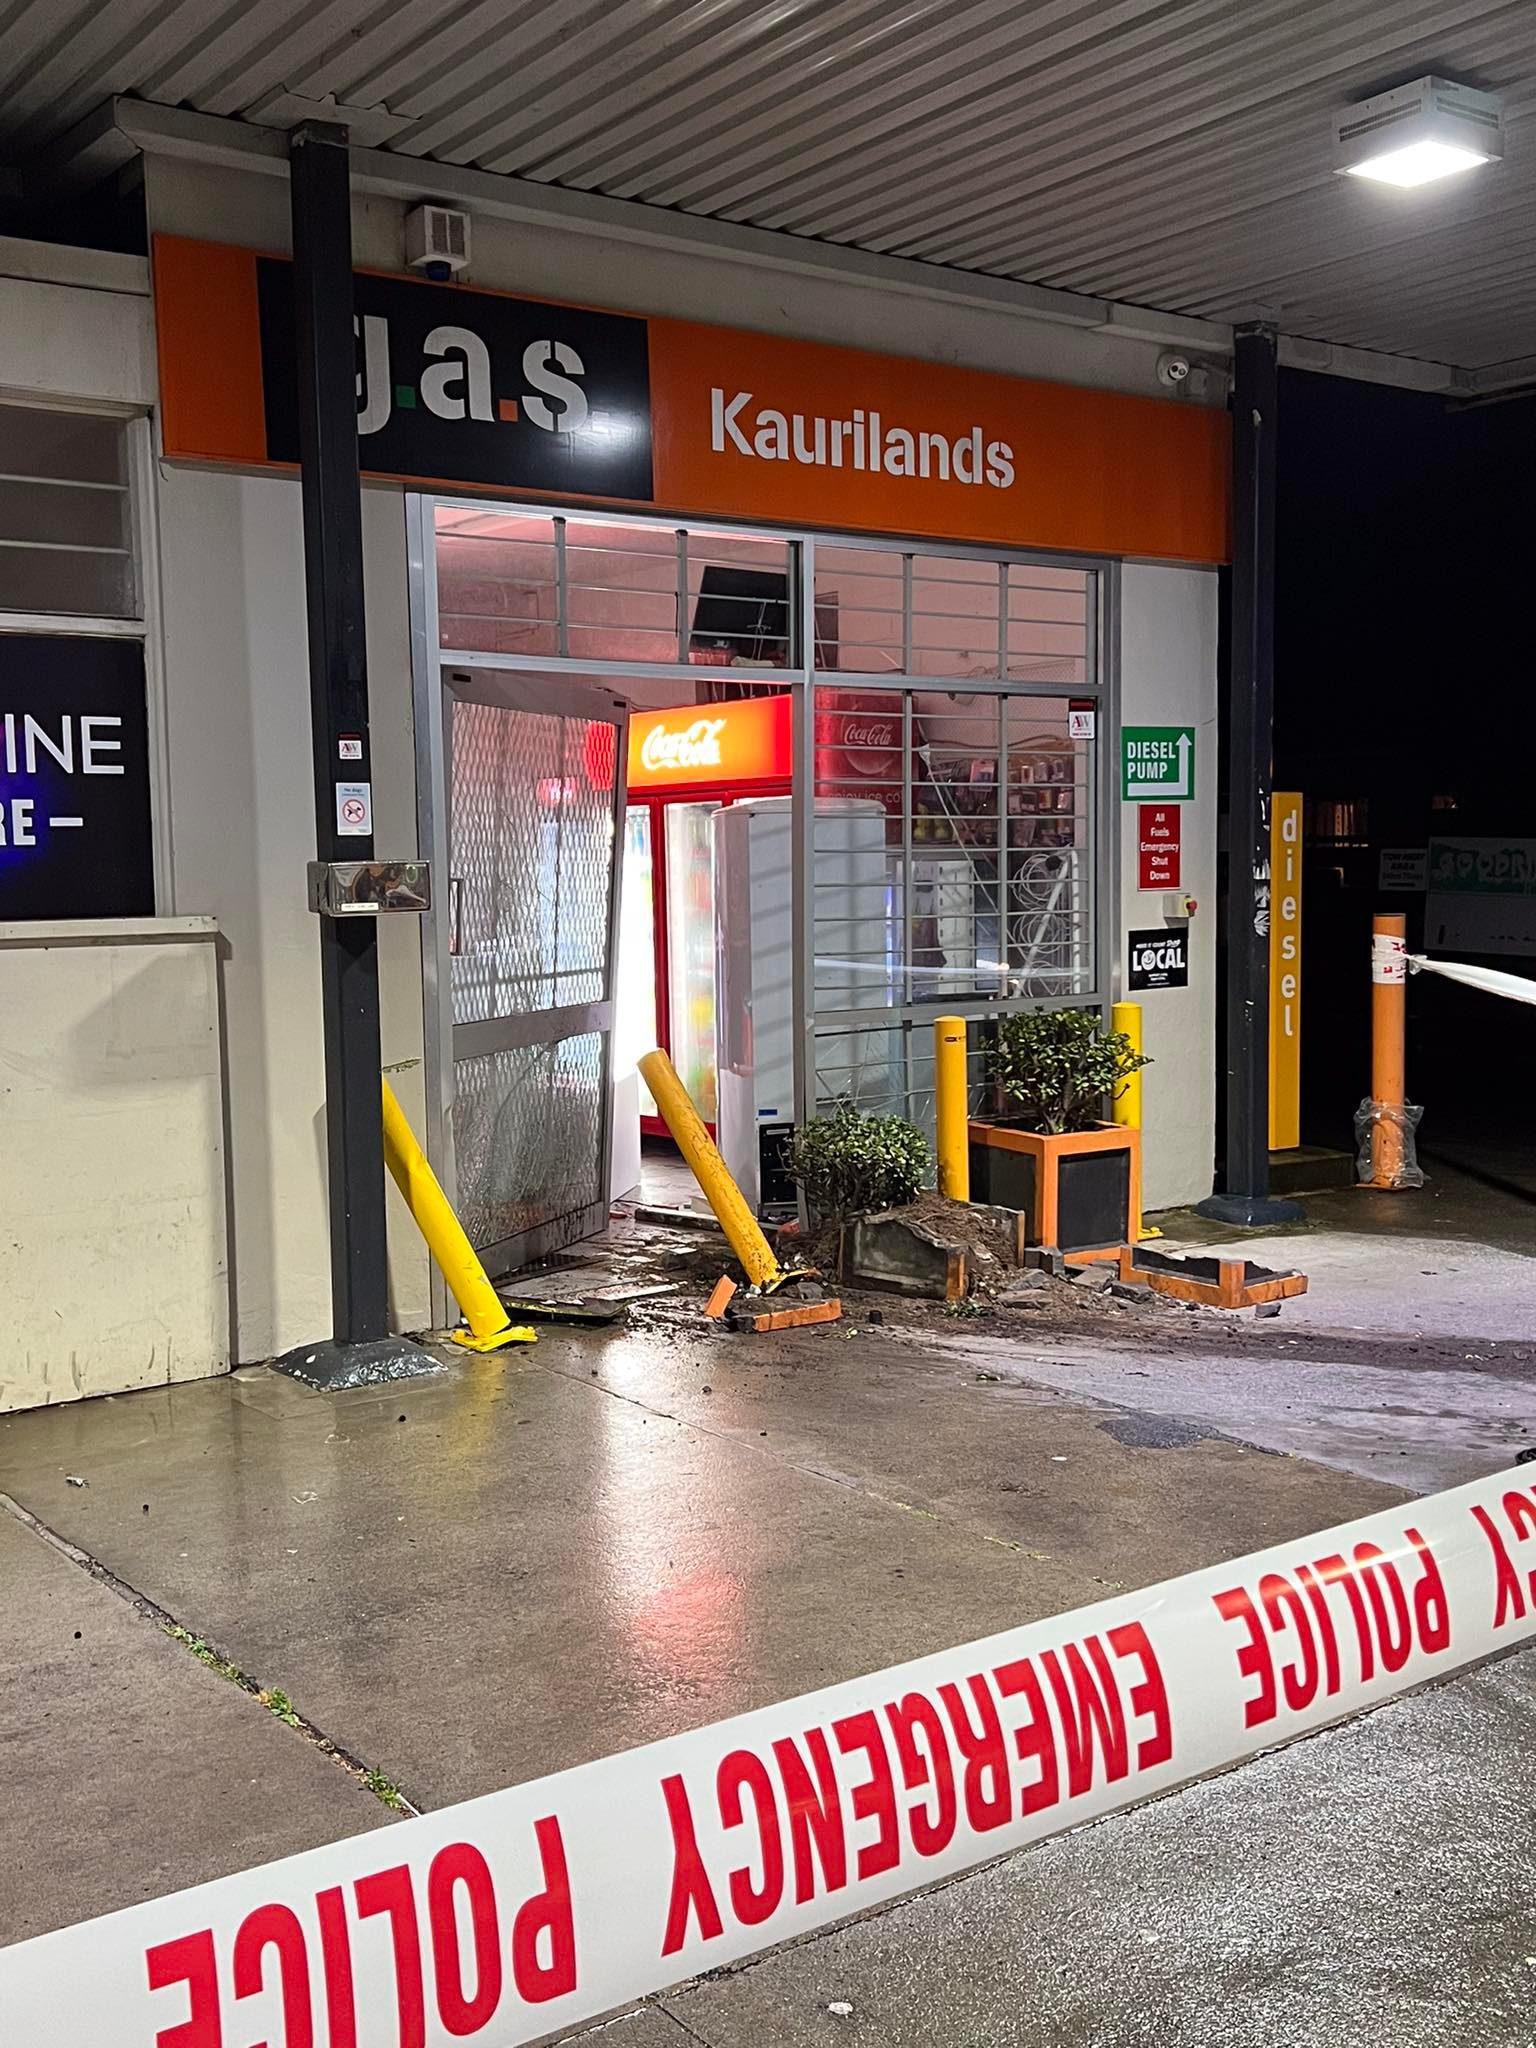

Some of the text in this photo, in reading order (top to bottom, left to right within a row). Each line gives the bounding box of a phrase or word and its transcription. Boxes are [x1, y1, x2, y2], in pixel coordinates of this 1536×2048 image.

[711, 388, 1015, 488] Kaurilands
[1127, 741, 1176, 759] DIESEL
[1127, 762, 1168, 779] PUMP
[0, 799, 36, 846] E
[1155, 813, 1165, 822] All
[1150, 827, 1170, 837] Fuels
[1140, 842, 1179, 853] Emergency
[1151, 857, 1169, 866] Shut
[1149, 871, 1170, 880] Down
[1281, 810, 1297, 1036] diesel
[1133, 948, 1186, 972] LOCAL
[1212, 1528, 1450, 1729] POLICE
[661, 1621, 1173, 1957] EMERGENCY
[146, 1815, 577, 2048] POLICE
